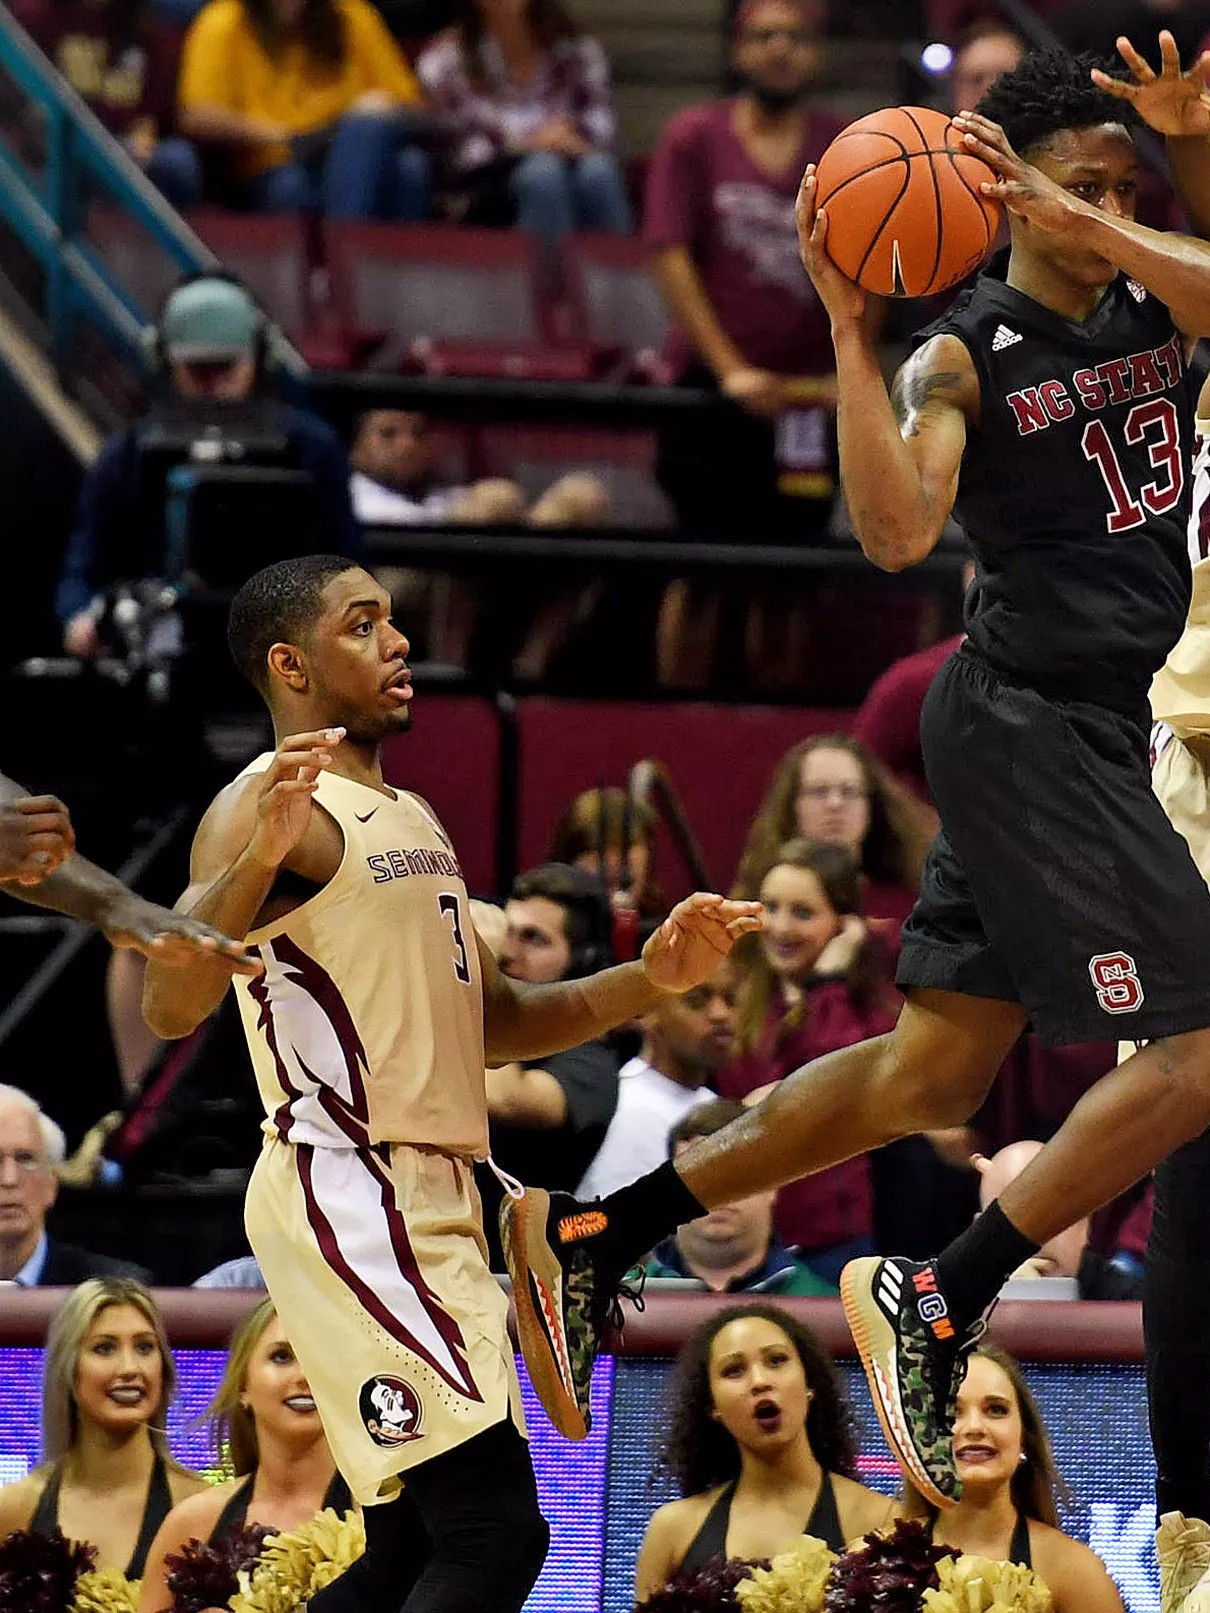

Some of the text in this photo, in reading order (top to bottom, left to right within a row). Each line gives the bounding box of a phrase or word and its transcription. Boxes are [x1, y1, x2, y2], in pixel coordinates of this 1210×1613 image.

[1006, 332, 1182, 437] NC STAT
[1081, 397, 1184, 533] 13
[367, 848, 462, 884] SEMINO
[437, 892, 471, 985] 3
